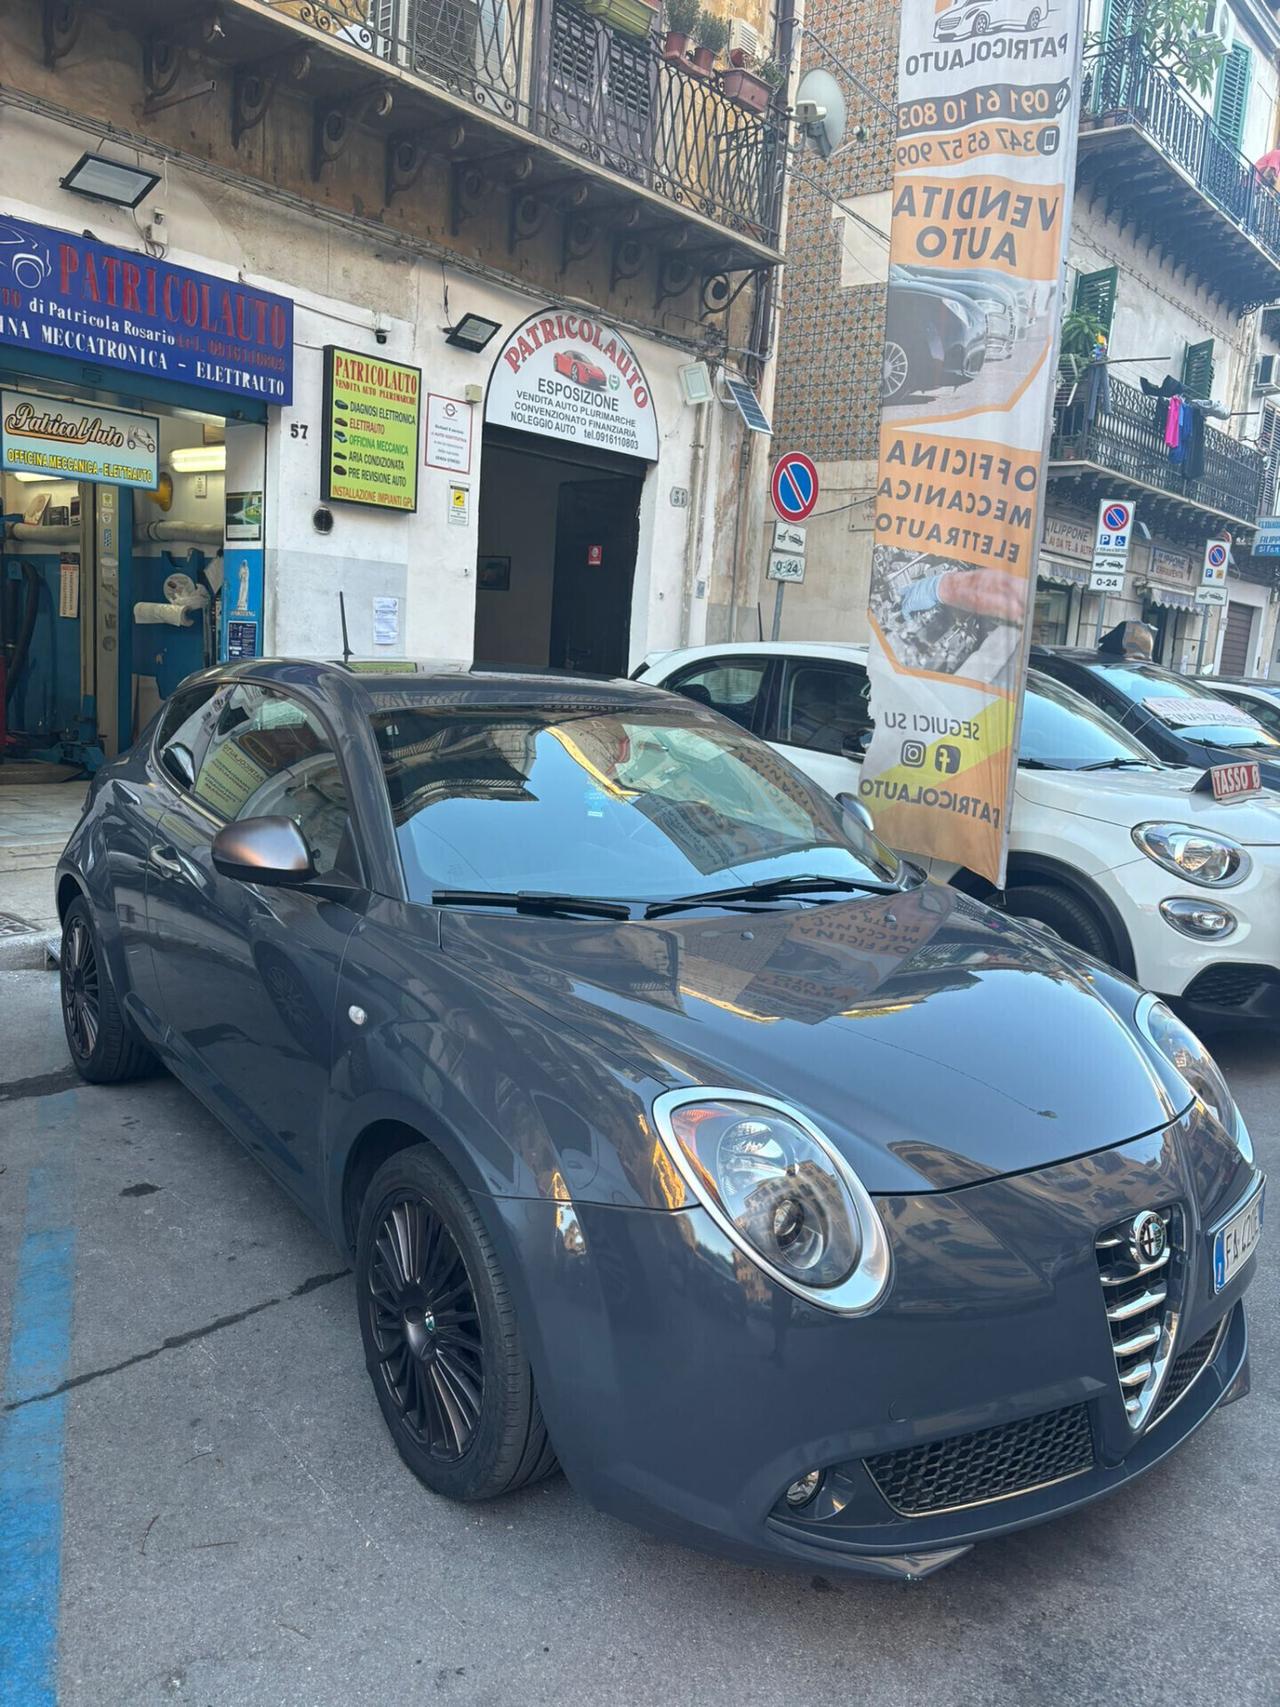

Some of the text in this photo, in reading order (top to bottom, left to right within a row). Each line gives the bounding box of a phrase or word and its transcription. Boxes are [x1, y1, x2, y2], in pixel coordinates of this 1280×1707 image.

[59, 243, 286, 349] PATRICOLAUTO
[29, 297, 44, 314] di
[49, 301, 119, 333] Patricola
[124, 320, 175, 345] Rosario
[41, 324, 167, 370] MECCATRONICA
[196, 361, 284, 396] ELETTRAUTO
[335, 355, 417, 395] PATRICOLAUTO
[504, 315, 648, 408] PATRICOLAUTO
[516, 390, 637, 427] VENDITA AUTO PLURIMARCHE
[538, 377, 619, 412] ESPOSIZIONE
[5, 402, 124, 448] PatricolAuto
[349, 417, 385, 435] ELETTRAUTO
[350, 401, 416, 425] DIAGNOSI ELETTRONICA
[510, 411, 553, 431] NOLEGGIO
[554, 421, 576, 436] AUTO
[514, 401, 637, 439] CONVENZIONATO FINANZIARIA
[290, 423, 308, 440] 57
[349, 434, 409, 456] OFFICINA MECCANICA
[7, 448, 47, 467] OFFICINA
[48, 455, 98, 475] MECCANICA
[103, 463, 153, 483] ELETTRAUTO
[348, 451, 405, 471] ARIA CONDIZIONATA
[348, 467, 407, 488] PRE REVISIONE AUTO
[1096, 578, 1117, 587] 0-24
[1214, 766, 1248, 794] TASSO
